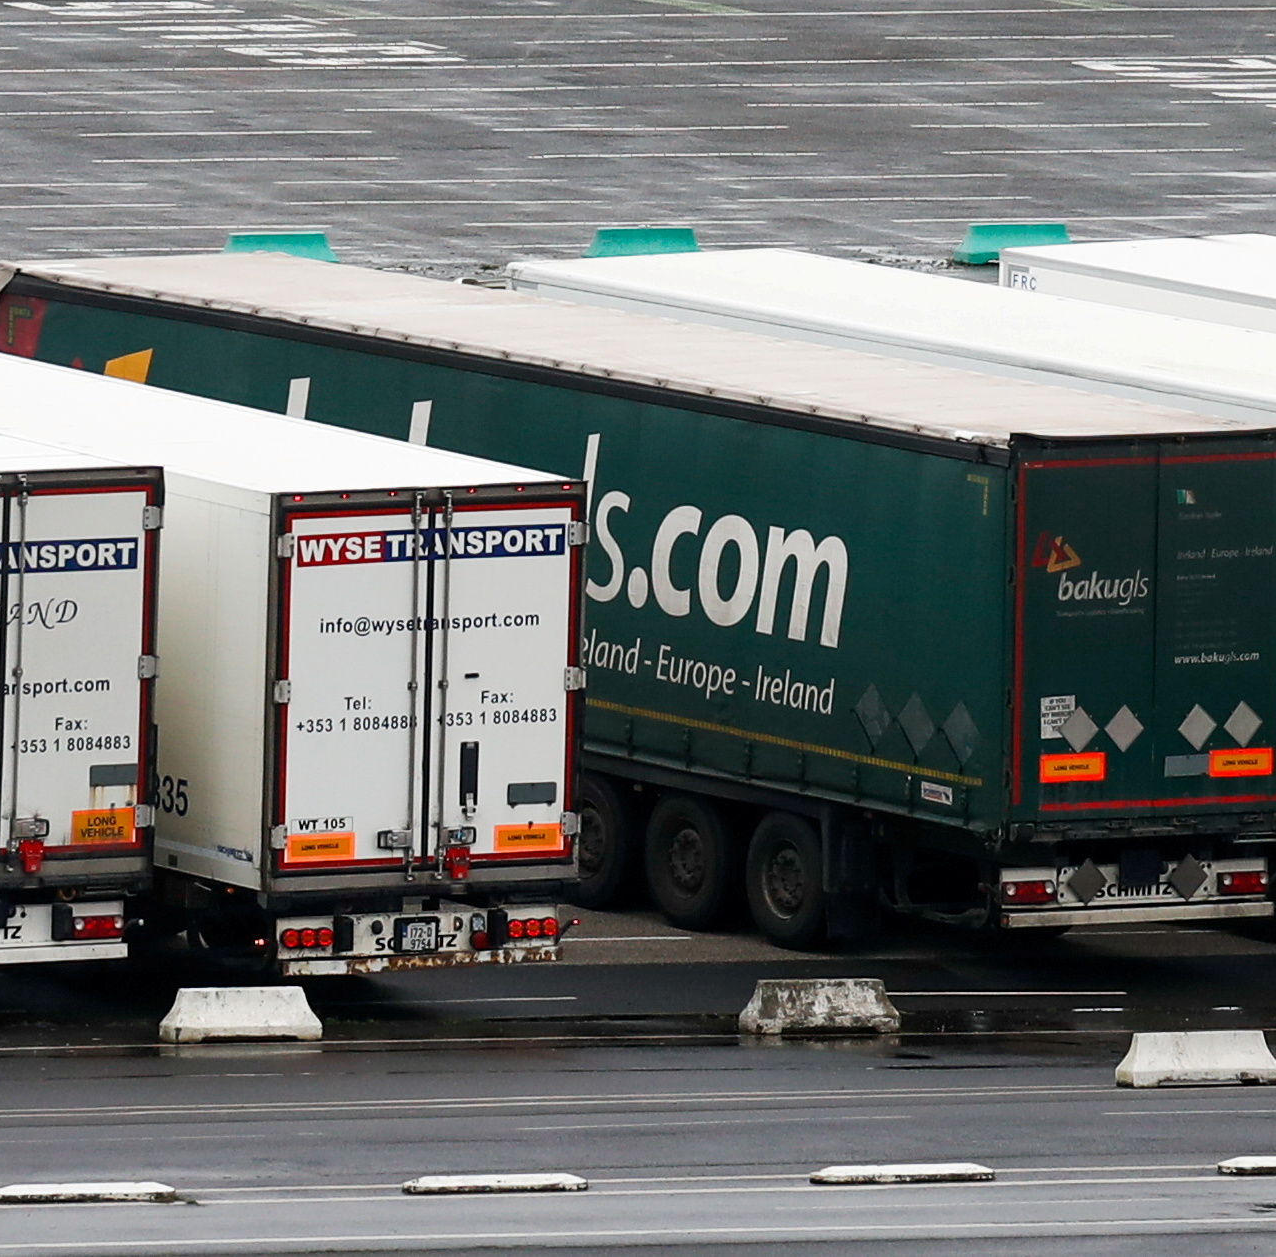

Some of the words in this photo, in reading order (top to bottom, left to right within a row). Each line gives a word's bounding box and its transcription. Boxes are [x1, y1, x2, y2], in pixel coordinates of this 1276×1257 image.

[1013, 273, 1037, 291] FRC
[299, 535, 382, 563] WYSE
[386, 528, 563, 558] TRANSPORT
[1057, 569, 1149, 606] bakugls
[1174, 651, 1260, 665] www.bakugls.com
[656, 645, 736, 700] Europe
[755, 665, 835, 715] Ireland
[344, 696, 372, 710] Tel:
[480, 691, 514, 704] Fax:
[54, 716, 88, 731] Fax:
[479, 712, 486, 725] 1
[493, 708, 557, 725] 8084883
[296, 718, 333, 733] +353
[339, 718, 346, 731] 1
[53, 738, 60, 752] 1
[67, 735, 131, 752] 8084883
[87, 815, 117, 827] LONG
[298, 819, 318, 830] WT
[323, 818, 346, 829] 105
[80, 826, 124, 839] VEHICLE
[1094, 881, 1173, 898] SCHMITZ
[374, 933, 457, 951] SCTZ
